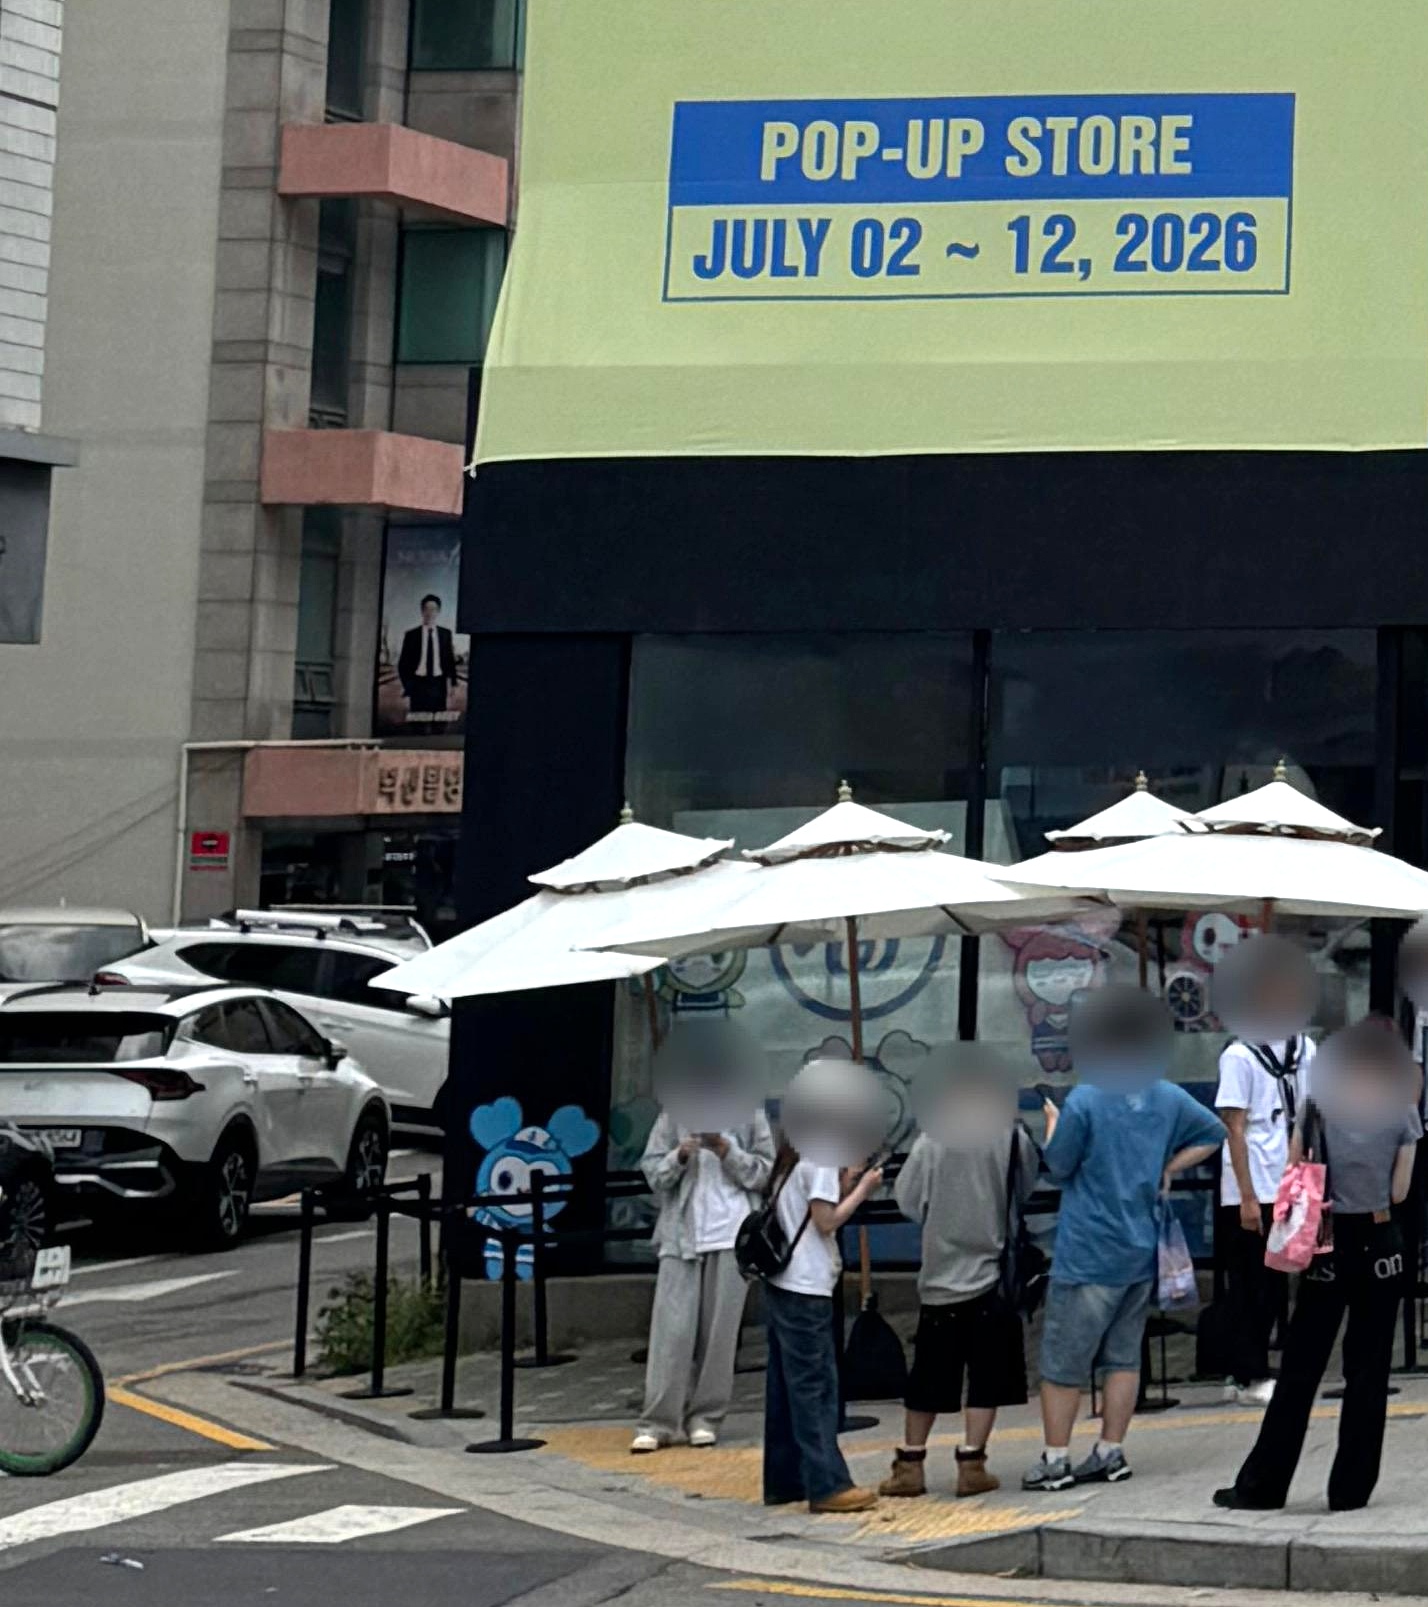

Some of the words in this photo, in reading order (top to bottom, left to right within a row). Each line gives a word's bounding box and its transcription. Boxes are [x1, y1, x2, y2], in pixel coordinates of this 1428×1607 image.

[760, 117, 984, 181] POP-UP
[1005, 115, 1193, 176] STORE
[693, 218, 832, 280] JULY
[849, 217, 922, 277] 02
[1007, 214, 1091, 280] 12,
[1114, 213, 1258, 274] 2026
